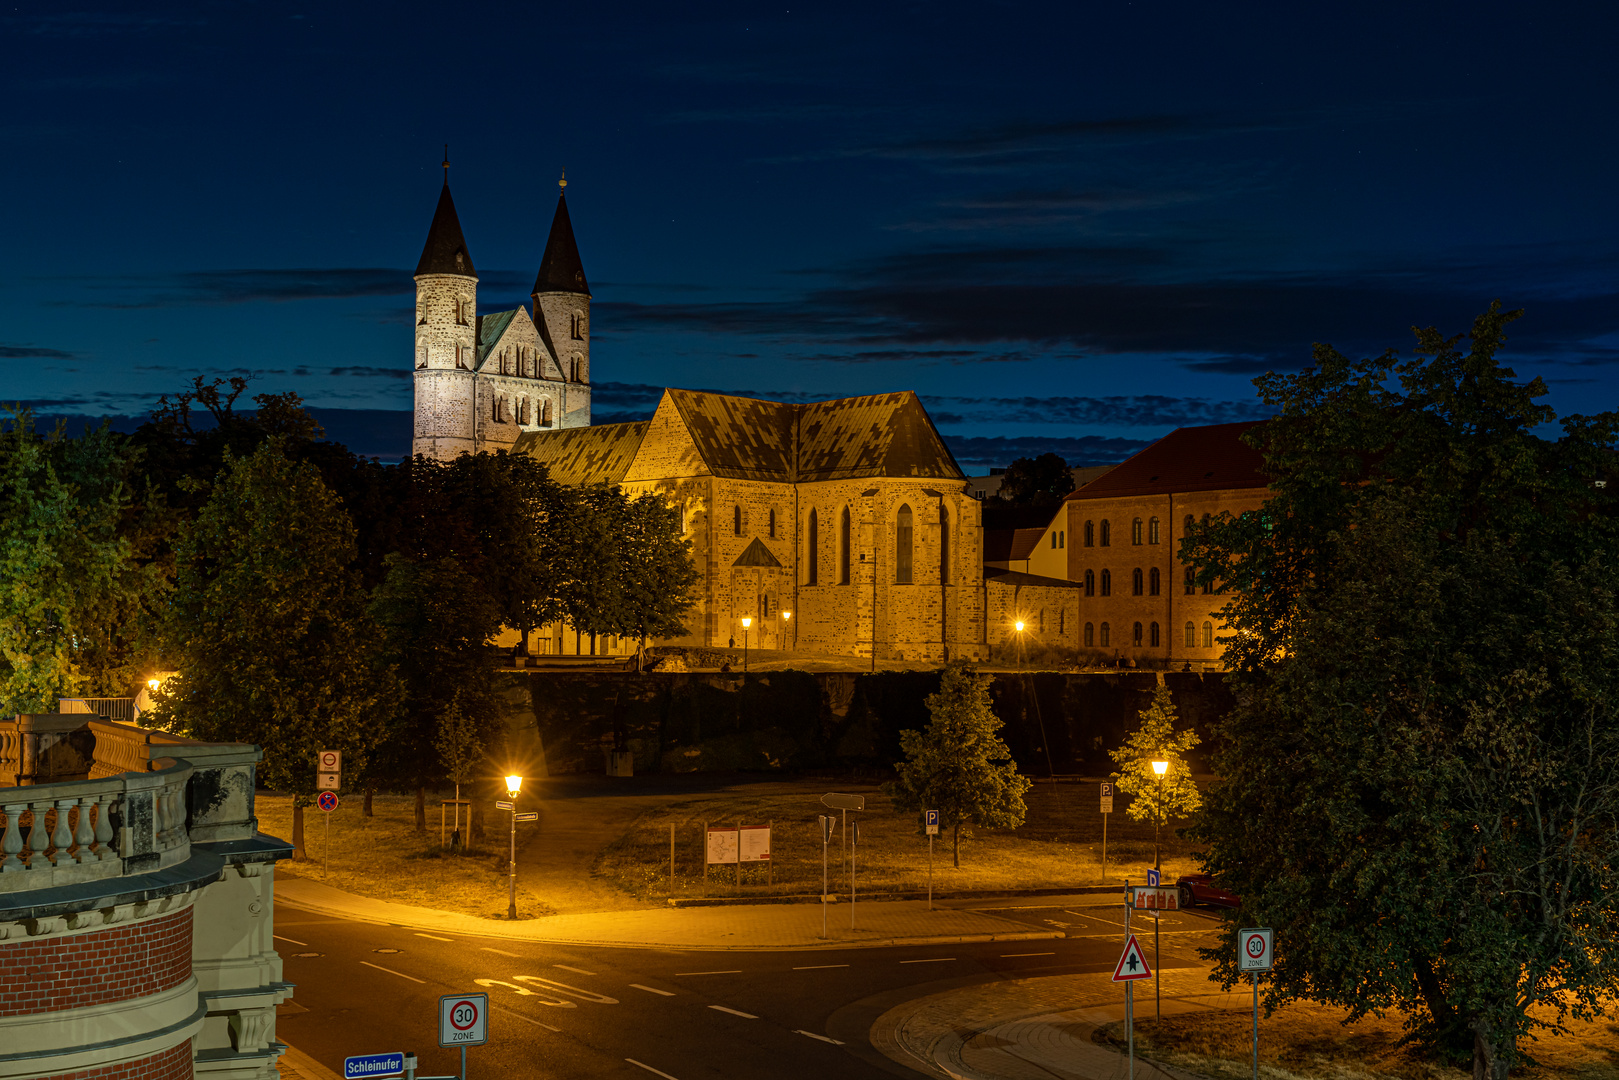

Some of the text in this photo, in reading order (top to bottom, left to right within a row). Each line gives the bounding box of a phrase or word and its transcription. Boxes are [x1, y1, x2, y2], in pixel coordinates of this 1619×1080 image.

[1103, 785, 1109, 795] P
[929, 812, 936, 824] P
[1250, 940, 1262, 952] 30
[473, 975, 620, 1009] 30
[456, 1008, 472, 1023] 30
[453, 1031, 474, 1041] ZONE
[347, 1058, 401, 1074] Schleinufer
